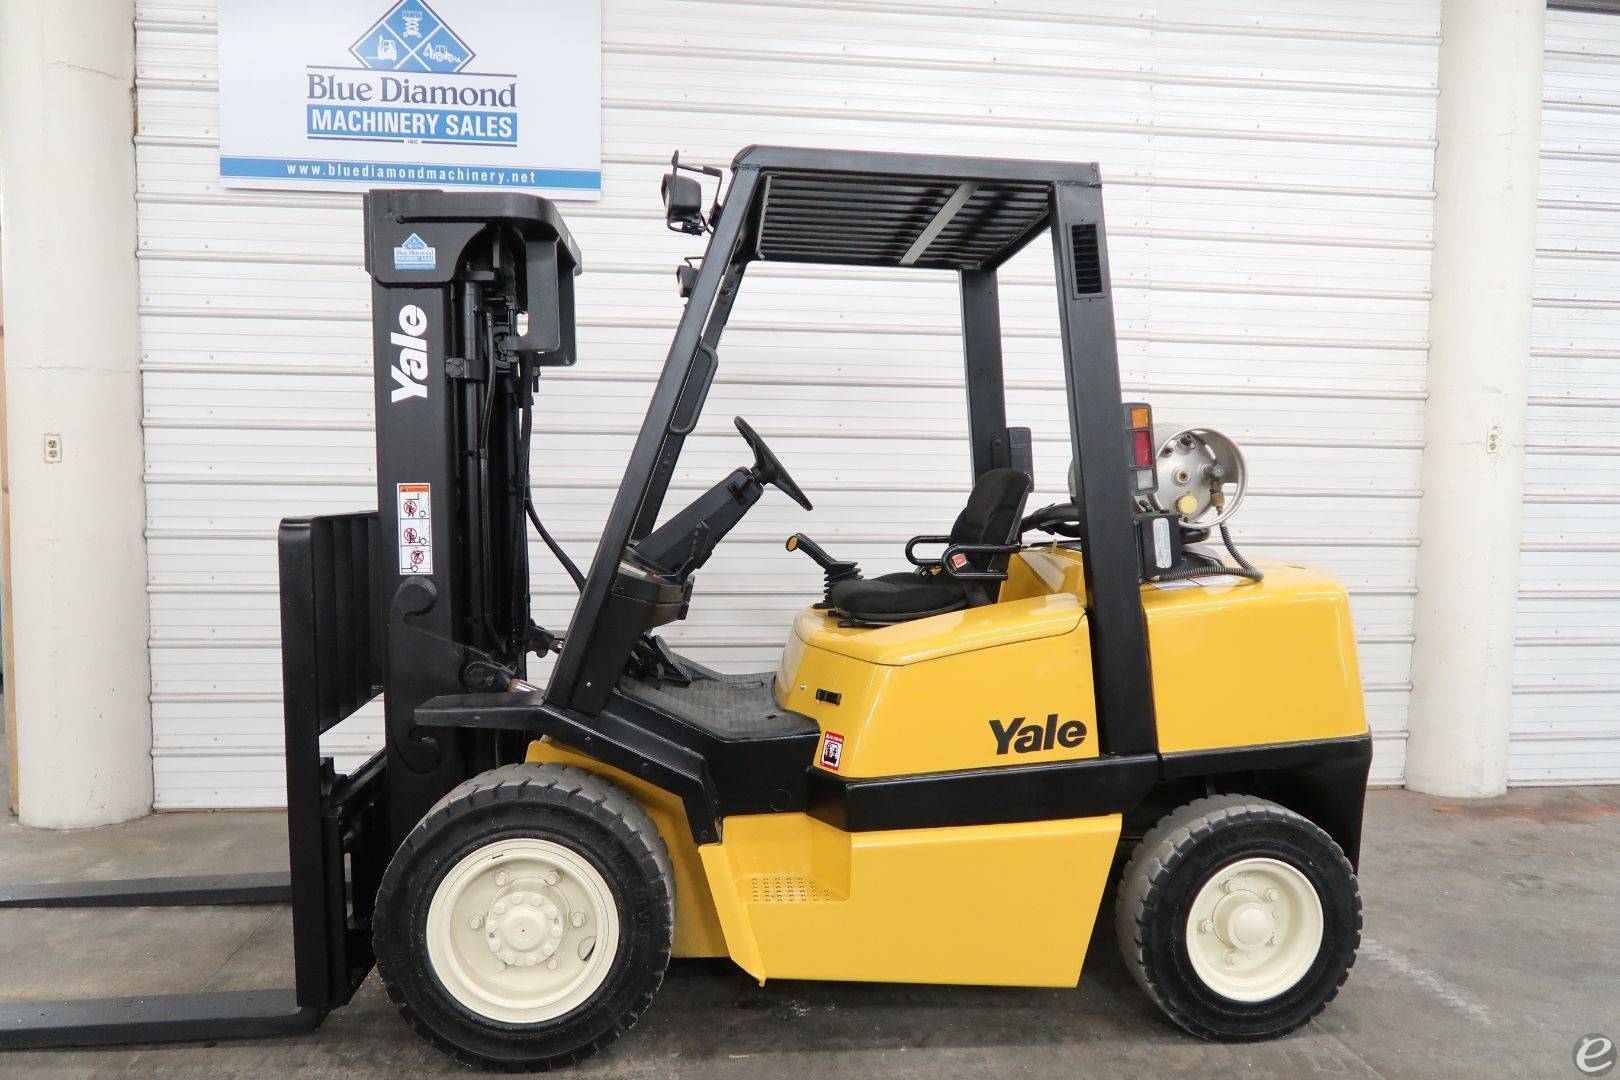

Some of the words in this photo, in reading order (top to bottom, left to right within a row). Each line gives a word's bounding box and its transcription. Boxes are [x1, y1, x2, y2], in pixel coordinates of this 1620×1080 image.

[307, 73, 373, 101] Blue
[380, 77, 517, 107] Diamond
[312, 108, 439, 134] MACHINERY
[445, 114, 512, 137] SALES
[286, 163, 536, 184] www.bluediamondmachinery.net
[391, 304, 428, 403] Yale
[989, 714, 1087, 755] Yale
